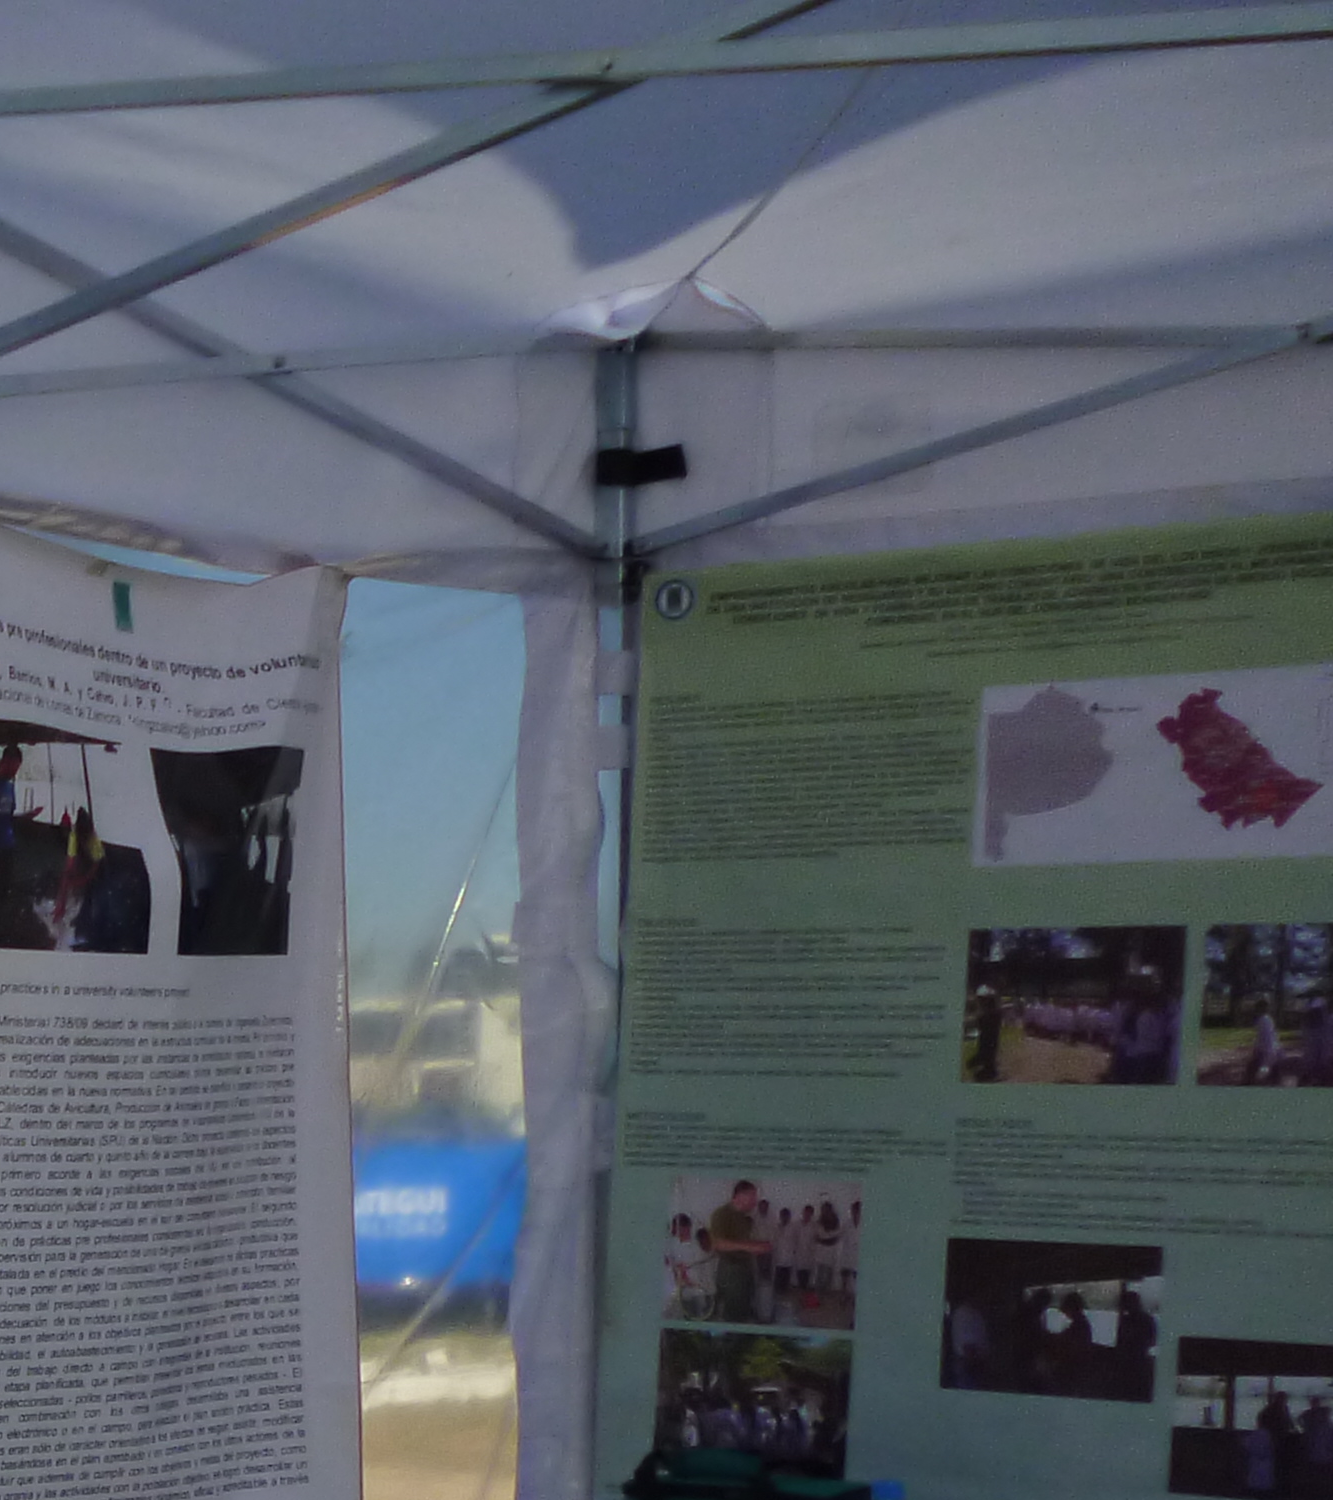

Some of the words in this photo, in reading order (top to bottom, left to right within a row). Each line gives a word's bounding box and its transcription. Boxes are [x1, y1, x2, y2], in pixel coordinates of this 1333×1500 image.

[98, 645, 132, 667] dentro
[170, 662, 222, 680] proyecto
[227, 665, 245, 679] de
